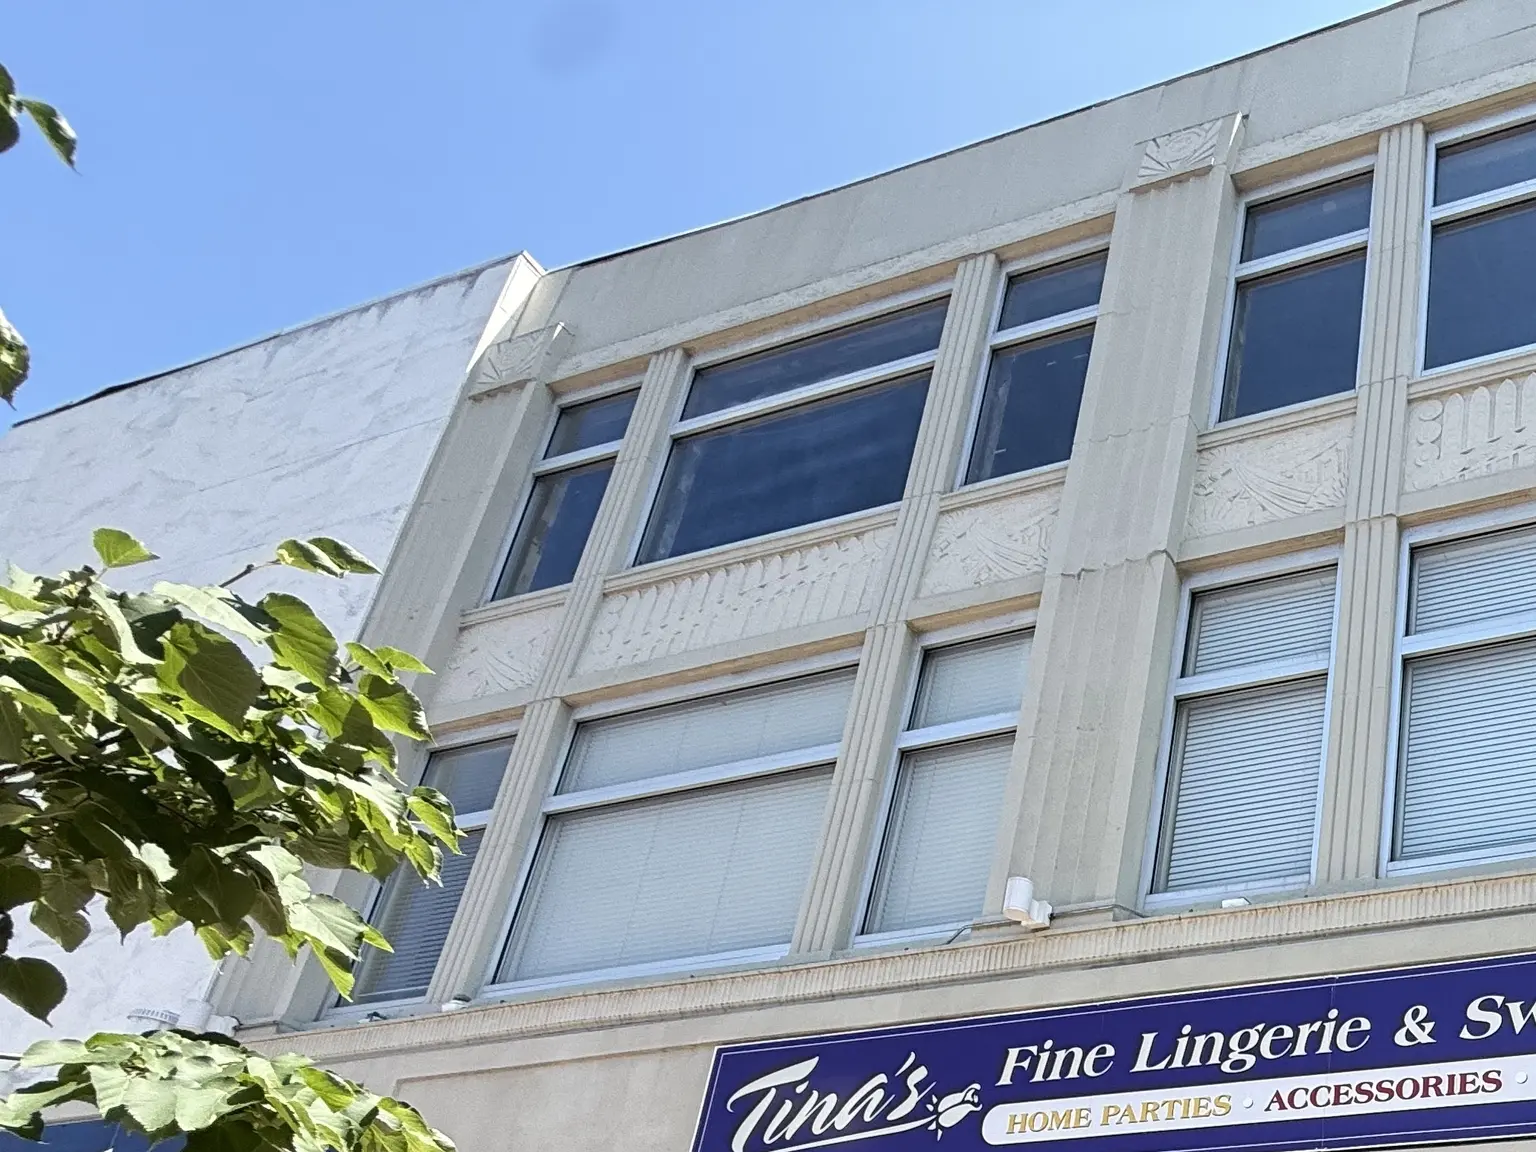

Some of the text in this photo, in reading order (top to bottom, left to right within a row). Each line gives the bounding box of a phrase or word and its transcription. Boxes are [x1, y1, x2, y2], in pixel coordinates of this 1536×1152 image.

[995, 1038, 1115, 1087] Fine
[1129, 1008, 1371, 1075] Lingerie
[1393, 1004, 1437, 1047] &
[1005, 1106, 1091, 1136] HOME
[1099, 1094, 1233, 1127] PARTIES
[1264, 1069, 1504, 1113] ACCESSORIES
